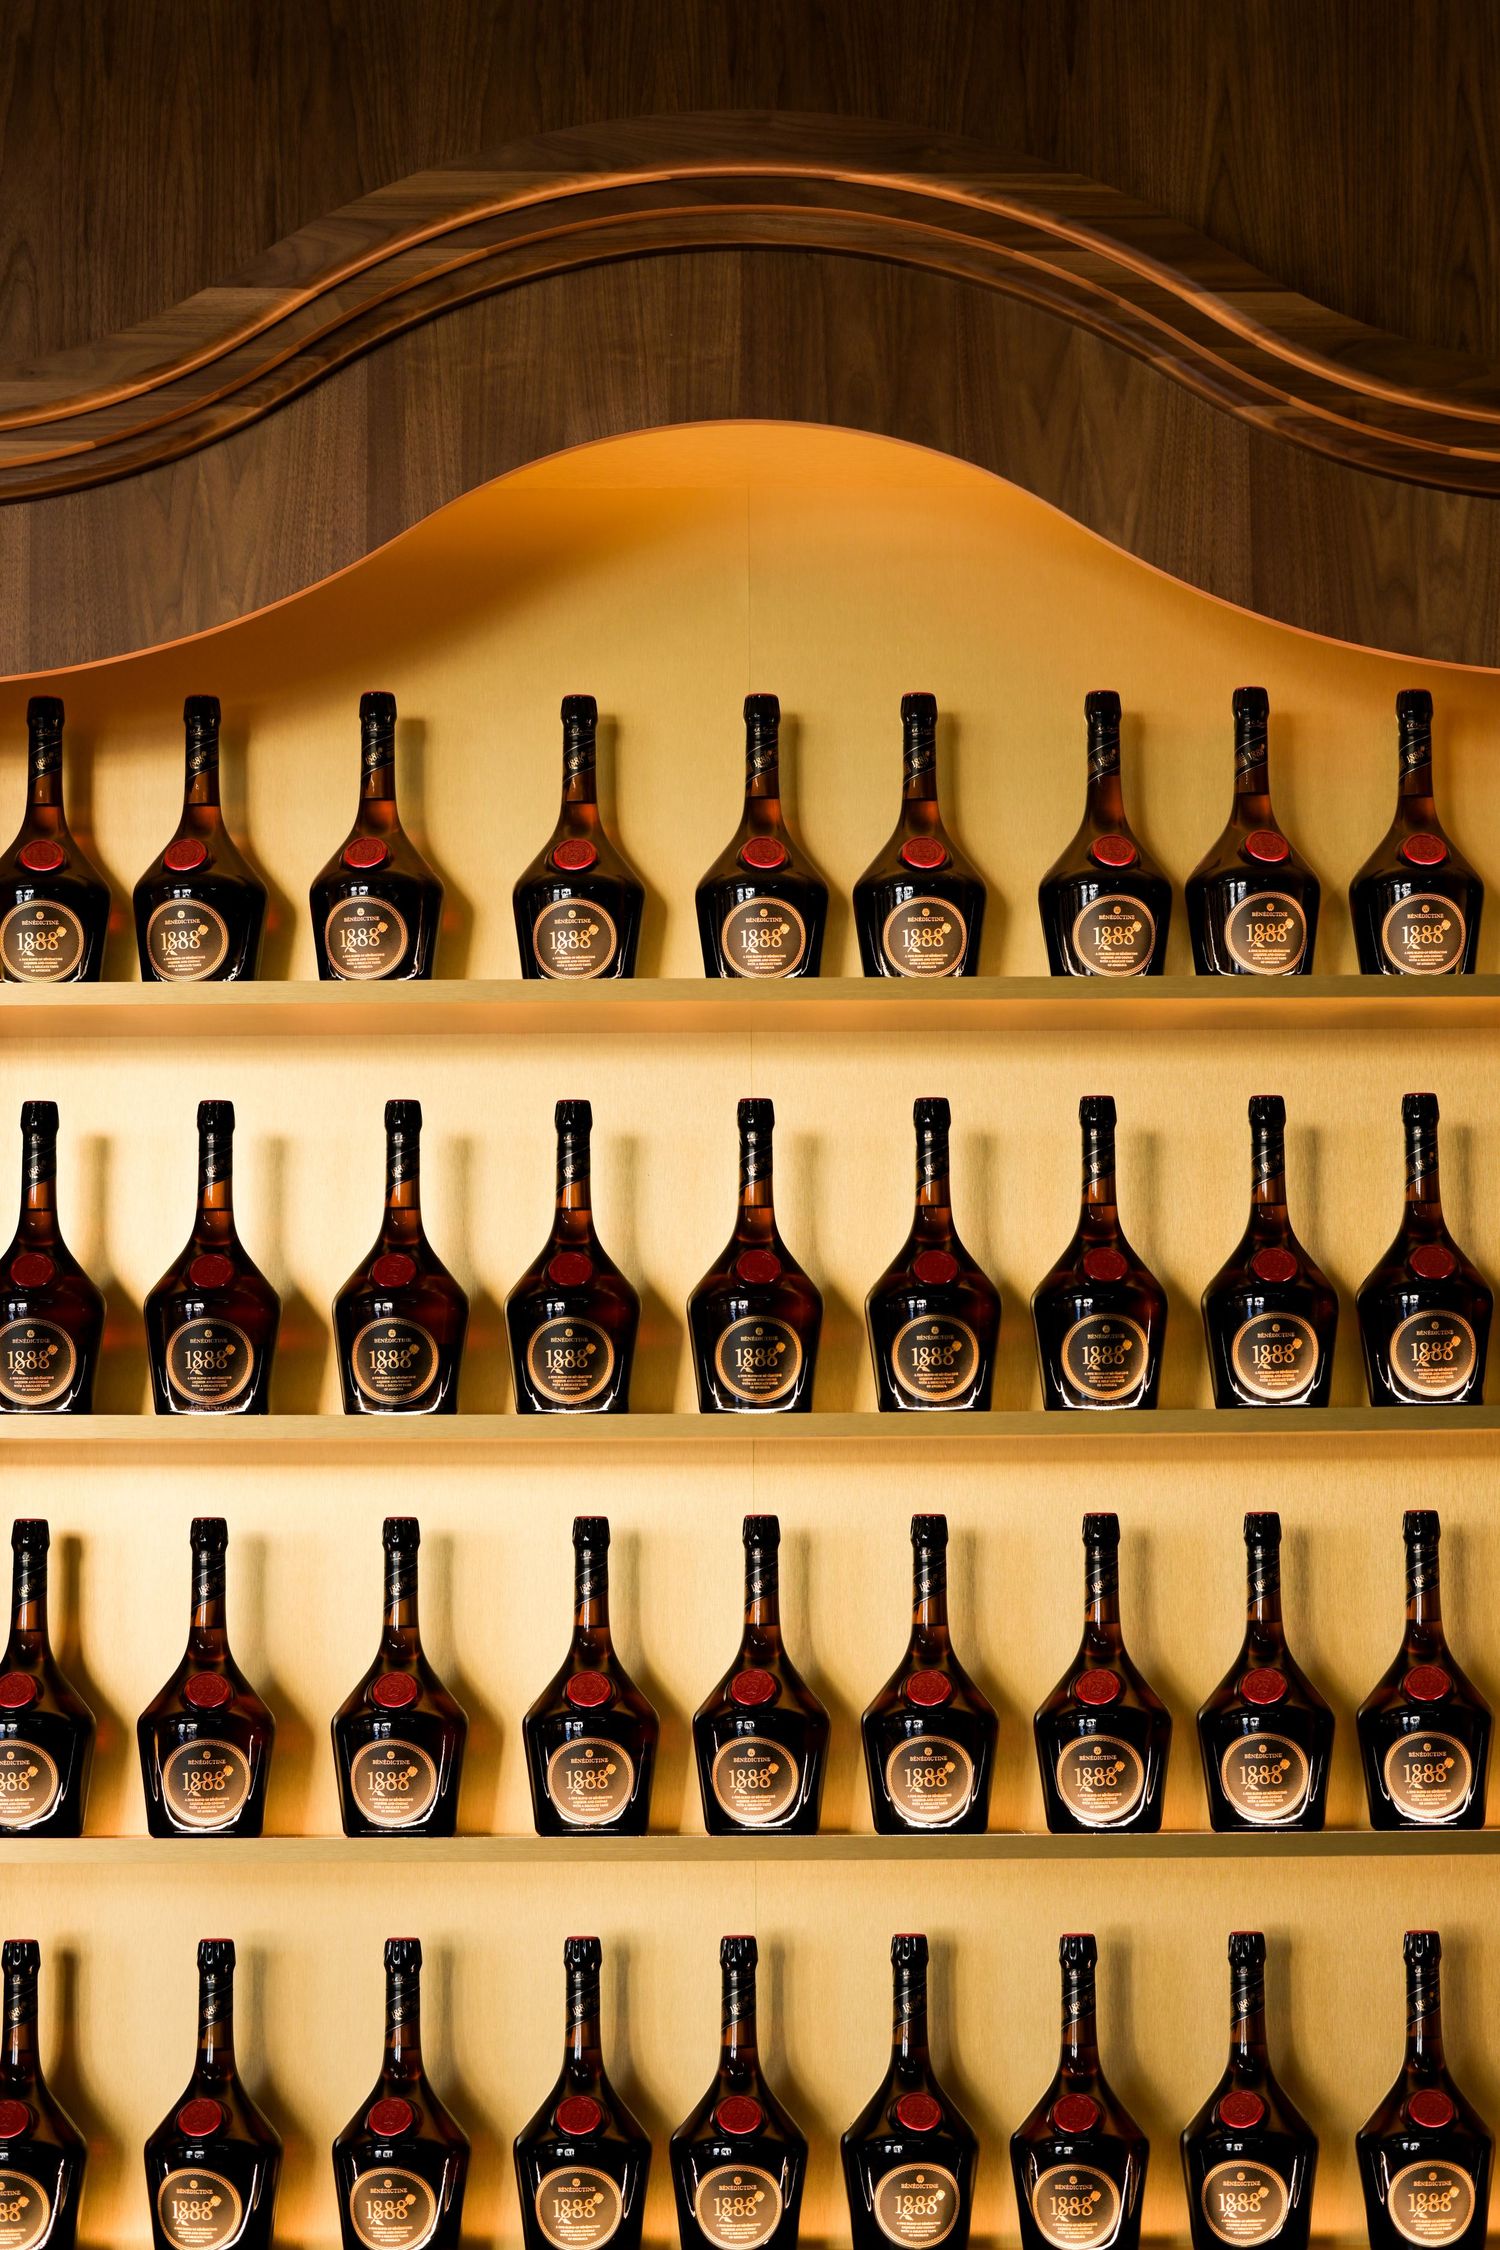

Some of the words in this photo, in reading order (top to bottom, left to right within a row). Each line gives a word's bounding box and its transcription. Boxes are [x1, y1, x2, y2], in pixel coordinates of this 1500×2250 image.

[16, 932, 59, 950] 1888
[161, 930, 200, 950] 1888
[340, 928, 379, 948] 1888
[550, 930, 592, 950] 1888
[741, 929, 782, 948] 1888
[902, 929, 944, 948] 1888
[1093, 926, 1134, 945] 1888
[1246, 924, 1288, 942] 1888
[1402, 925, 1444, 944] 1888
[7, 1350, 50, 1369] 1888
[185, 1350, 228, 1370] 1888
[369, 1350, 412, 1369] 1888
[546, 1350, 588, 1368] 1888
[736, 1348, 778, 1367] 1888
[912, 1347, 954, 1366] 1888
[1082, 1346, 1124, 1364] 1888
[1252, 1344, 1294, 1364] 1888
[1411, 1342, 1453, 1360] 1888
[182, 1772, 225, 1791] 1888
[368, 1771, 410, 1790] 1888
[566, 1770, 608, 1789] 1888
[728, 1769, 771, 1788] 1888
[904, 1768, 947, 1787] 1888
[1074, 1767, 1118, 1786] 1888
[1240, 1766, 1282, 1784] 1888
[1404, 1764, 1446, 1783] 1888
[172, 2200, 212, 2220] 1888
[366, 2200, 408, 2220] 1888
[552, 2199, 596, 2218] 1888
[714, 2197, 756, 2216] 1888
[896, 2196, 938, 2214] 1888
[1050, 2197, 1092, 2216] 1888
[1218, 2192, 1260, 2213] 1888
[1408, 2193, 1451, 2212] 1888
